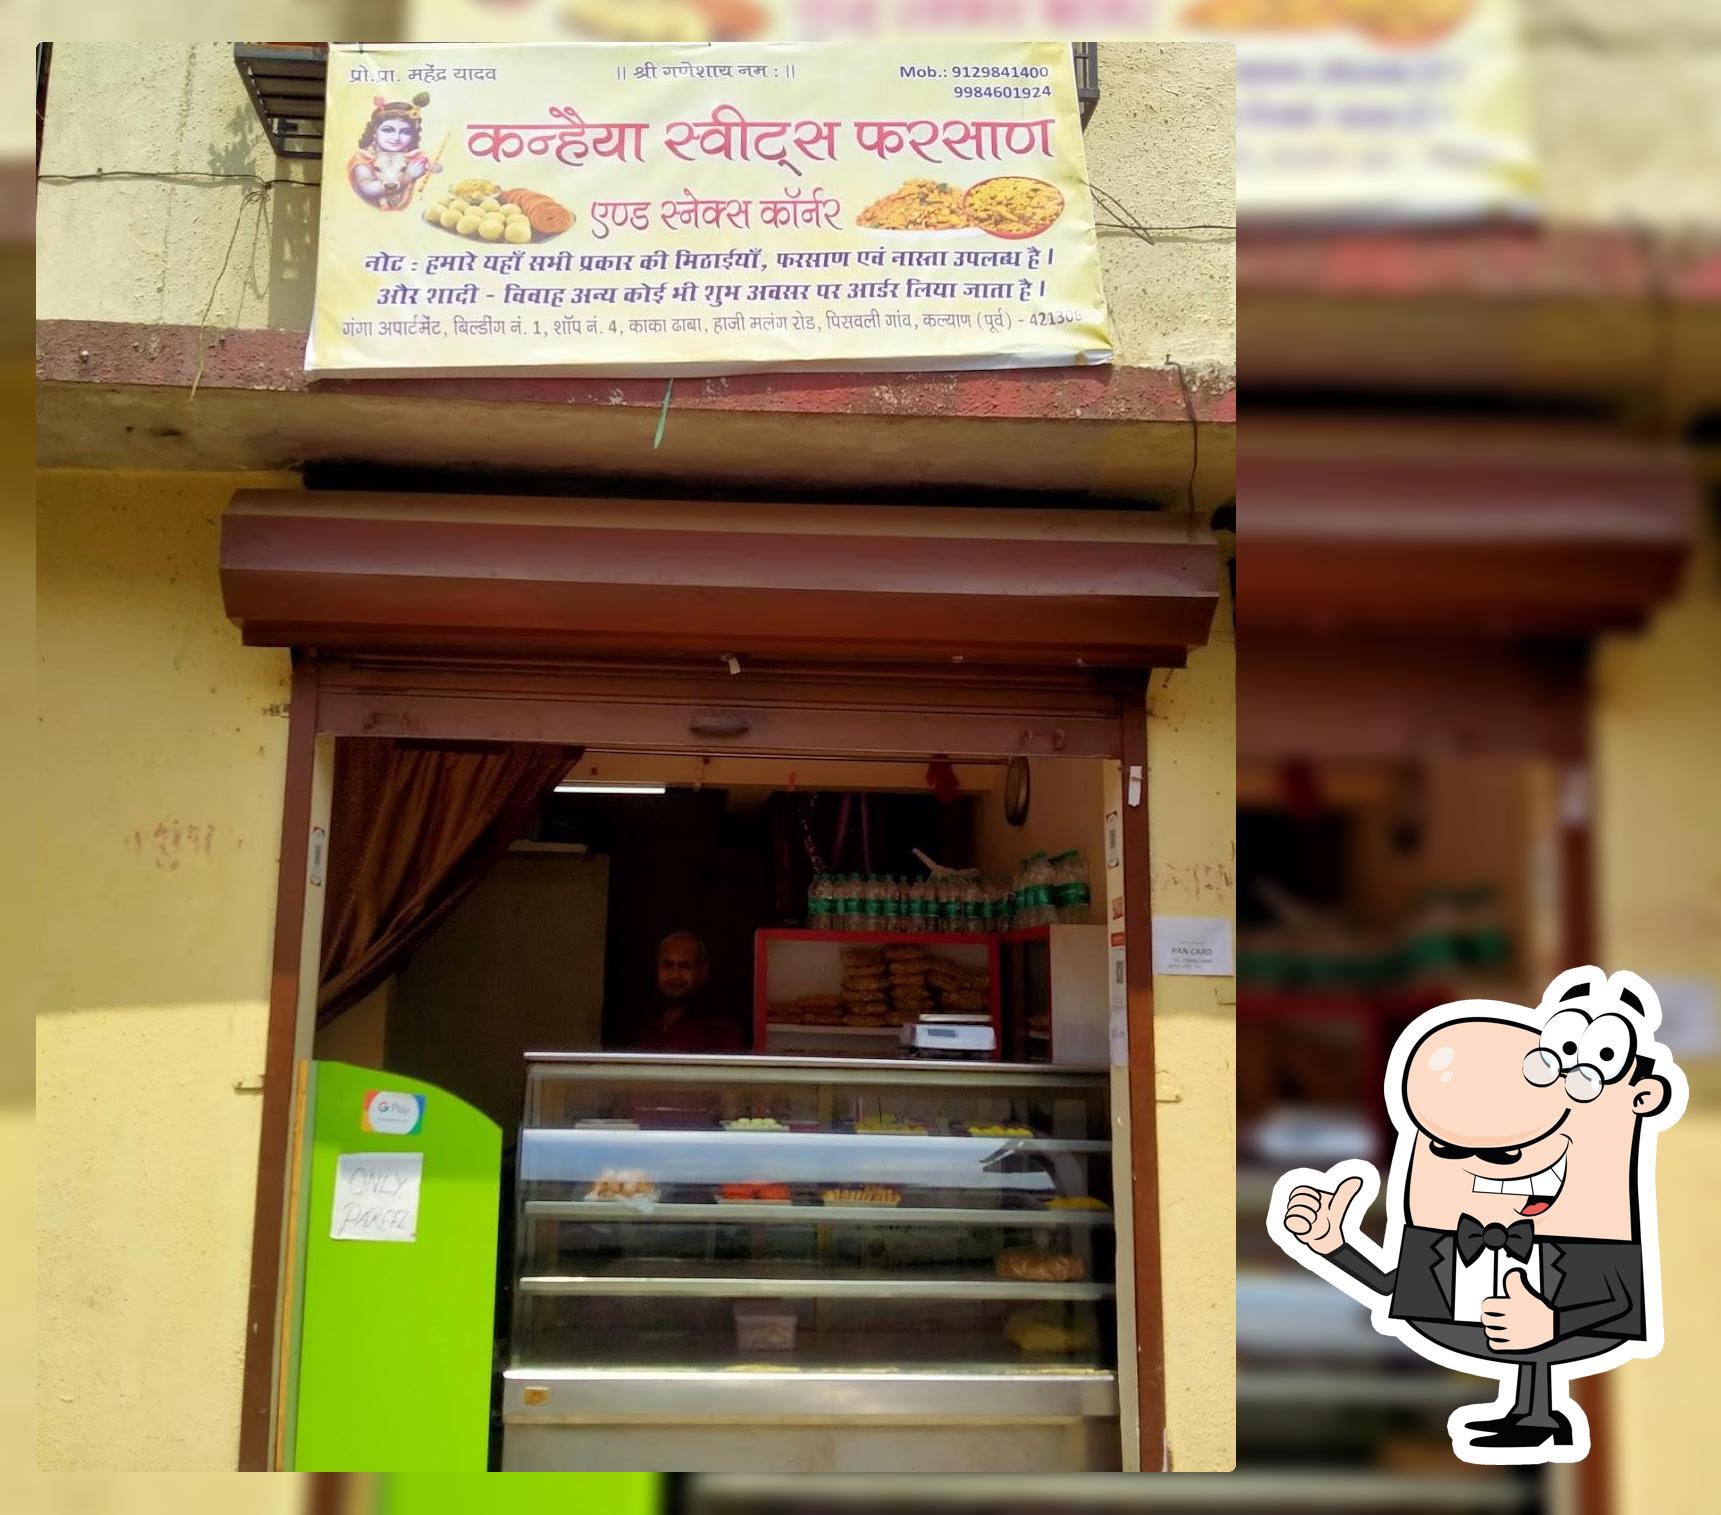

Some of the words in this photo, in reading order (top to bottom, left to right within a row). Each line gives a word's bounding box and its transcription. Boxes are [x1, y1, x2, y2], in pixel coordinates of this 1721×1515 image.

[408, 63, 447, 83] महेंद्र
[453, 67, 497, 81] यादव
[633, 61, 657, 79] श्री
[663, 61, 733, 79] गणेशाय
[900, 65, 948, 78] Mob.:
[951, 65, 1049, 79] 9129841400
[954, 85, 1052, 99] 9984601924
[466, 105, 650, 167] कन्हैया
[663, 103, 842, 177] स्वीट्स
[854, 118, 1056, 164] फरसाण
[591, 201, 652, 239] एण्ड
[661, 187, 752, 231] स्नेक्स
[759, 186, 843, 231] कॉर्नर
[425, 251, 480, 274] हमारे
[483, 250, 526, 275] यहाँ
[529, 250, 574, 272] सभी
[579, 254, 634, 272] प्रकार
[640, 249, 669, 271] की
[776, 251, 852, 269] फरसाण
[857, 246, 887, 267] एवं
[891, 250, 949, 268] नास्ता
[953, 250, 1022, 267] उपलब्ध
[377, 283, 420, 305] और
[427, 283, 480, 305] शादी
[503, 282, 567, 308] विवाह
[570, 287, 619, 304] अन्य
[623, 282, 668, 305] कोई
[672, 281, 700, 302] भी
[704, 284, 742, 308] शुभ
[746, 284, 811, 301] अवसर
[816, 283, 843, 300] पर
[846, 278, 900, 300] आर्डर
[906, 278, 959, 299] लिया
[963, 282, 1015, 299] जाता
[342, 316, 373, 337] गंगा
[510, 316, 527, 336] नं.
[533, 320, 548, 338] 1,
[553, 315, 582, 336] शॉप
[586, 315, 603, 335] नं.
[608, 319, 624, 336] 4,
[629, 318, 667, 335] काका
[713, 312, 746, 335] हाजी
[750, 312, 787, 331] मलंग
[792, 310, 822, 333] रोड,
[826, 308, 881, 330] पिसवली
[923, 313, 972, 329] कल्याण
[977, 307, 1012, 335] (पूर्व)
[348, 1166, 409, 1198] ONLY
